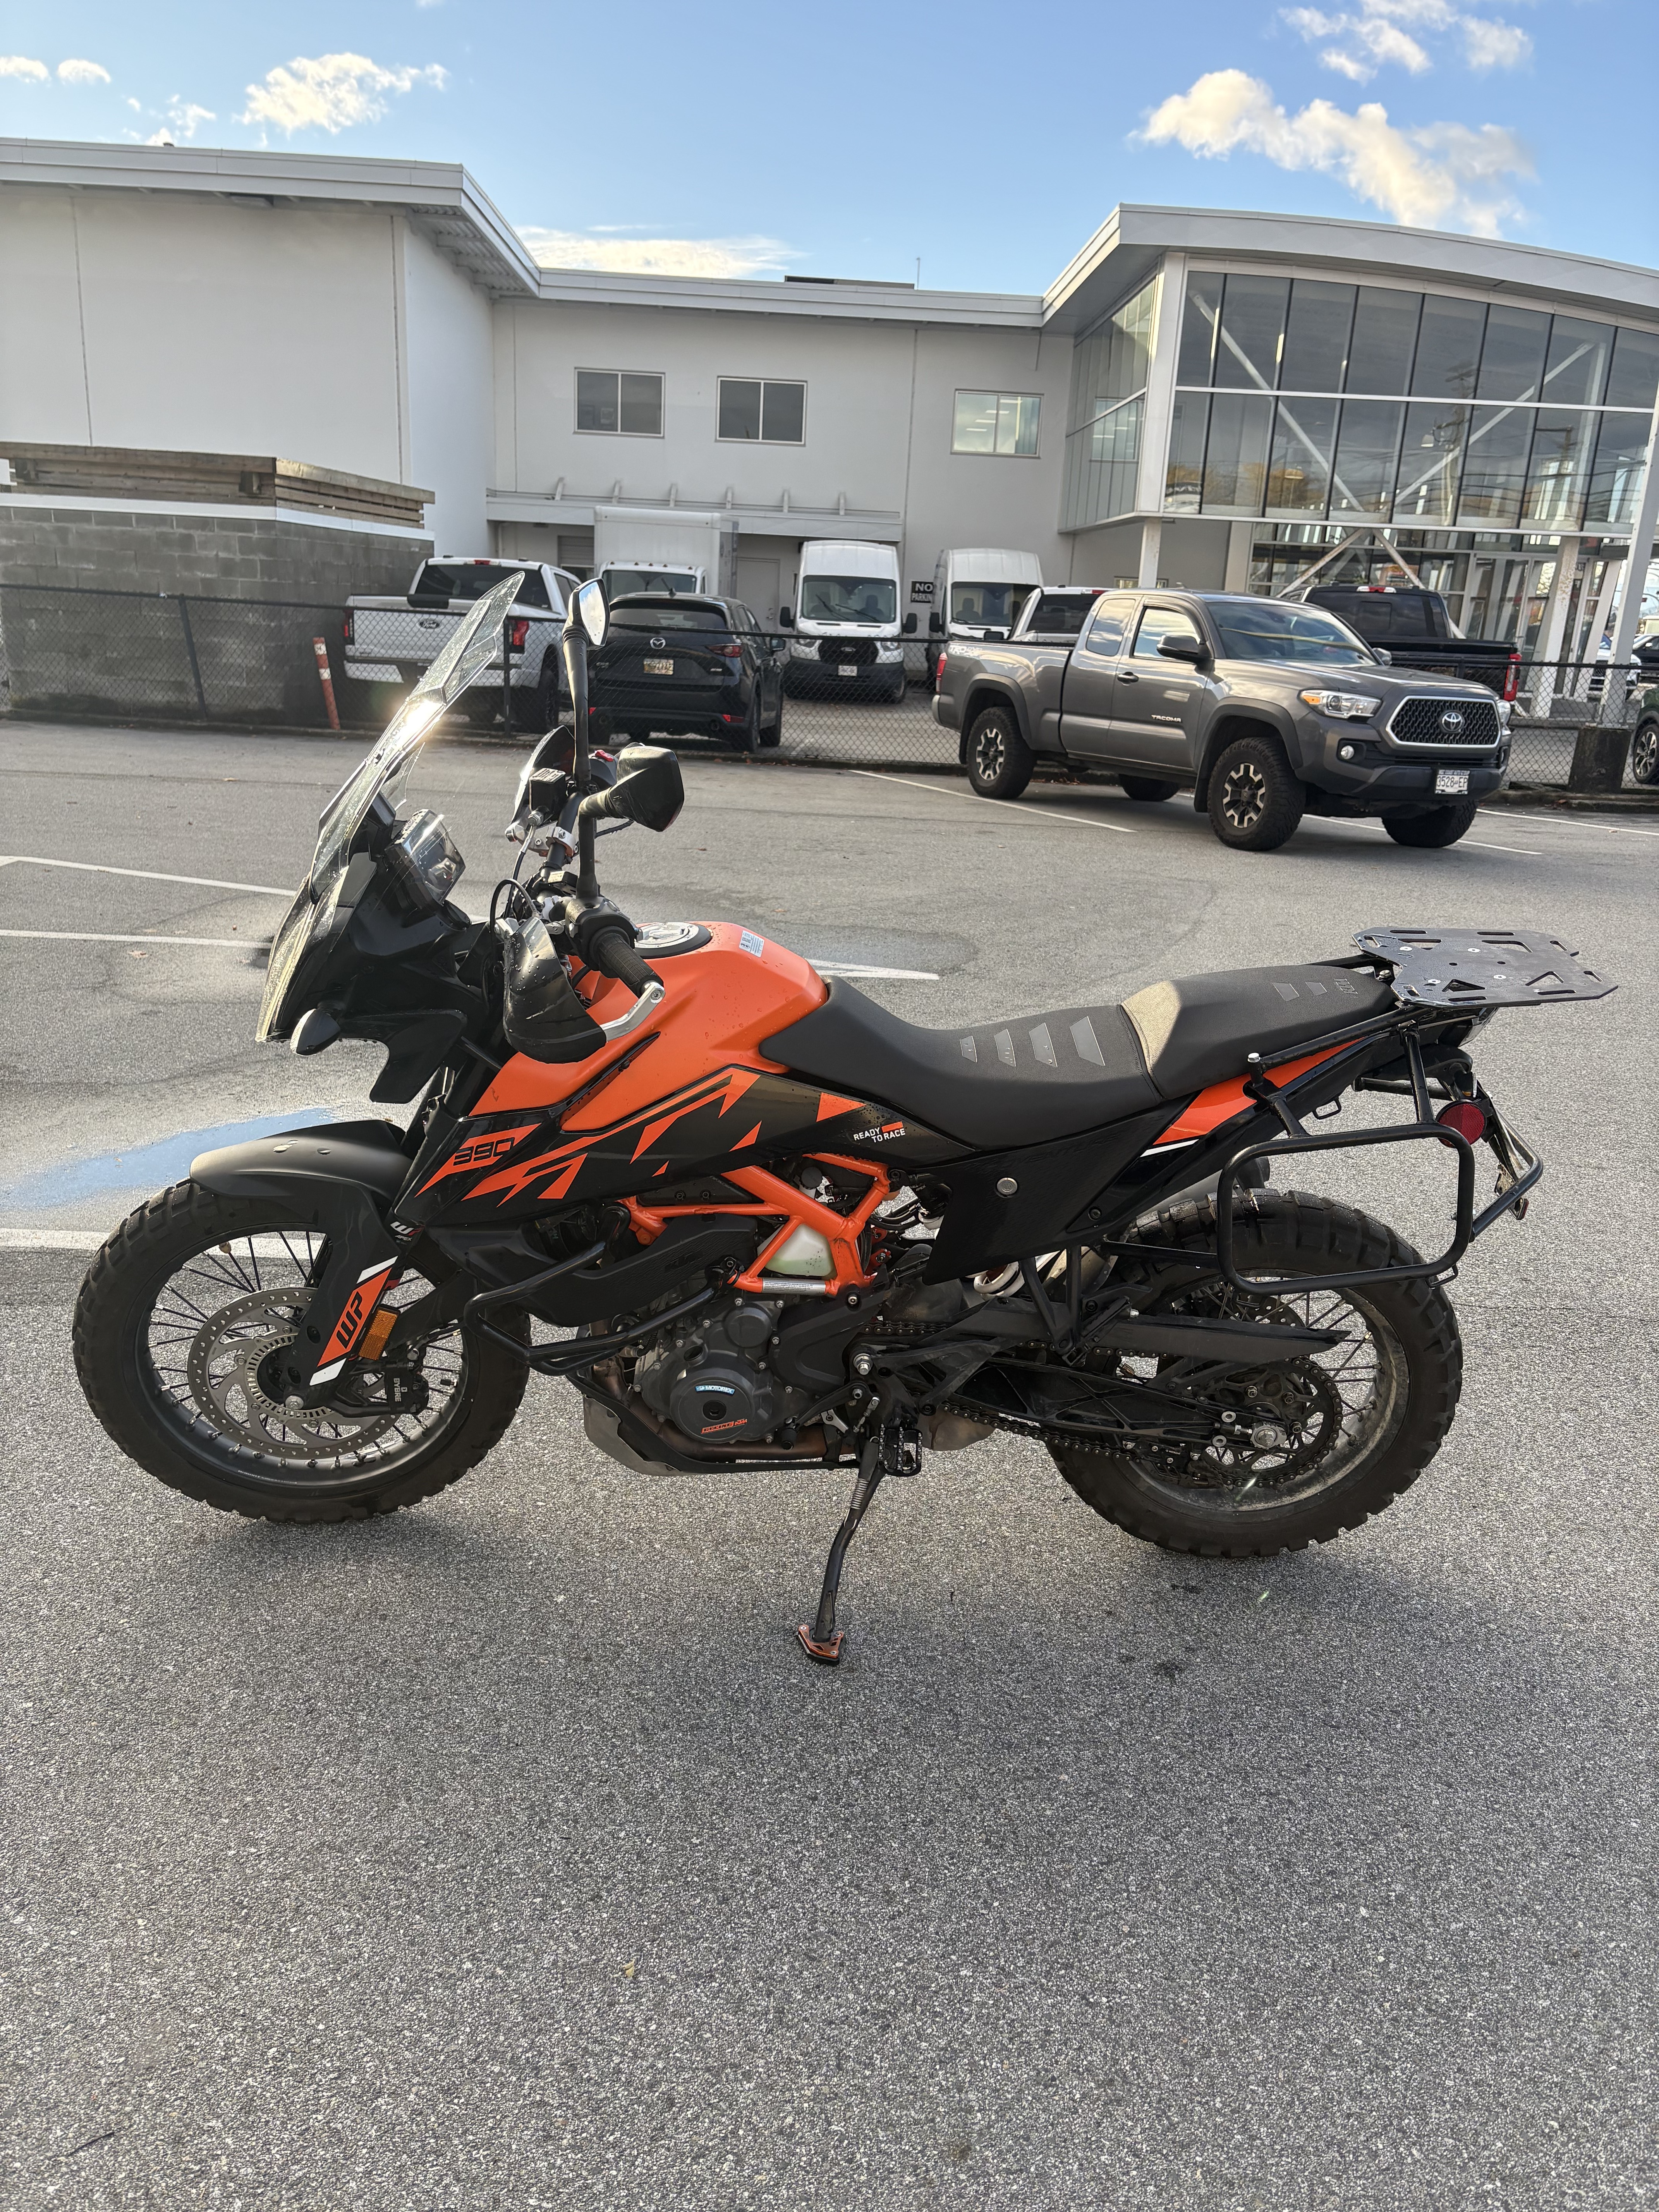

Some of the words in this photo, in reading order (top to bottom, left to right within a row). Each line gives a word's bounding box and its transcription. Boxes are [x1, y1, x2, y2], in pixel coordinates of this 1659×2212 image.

[915, 583, 933, 592] NO
[912, 593, 932, 601] PARKIN
[1151, 714, 1182, 723] TACOMA
[1436, 776, 1455, 787] 3528
[1458, 777, 1468, 788] EP
[853, 1127, 880, 1141] READY
[871, 1135, 883, 1143] TO
[883, 1128, 905, 1140] RACE
[453, 1137, 515, 1166] 390
[336, 1291, 362, 1349] WP
[393, 1378, 402, 1402] BYBRE
[705, 1385, 733, 1394] MOTOREX
